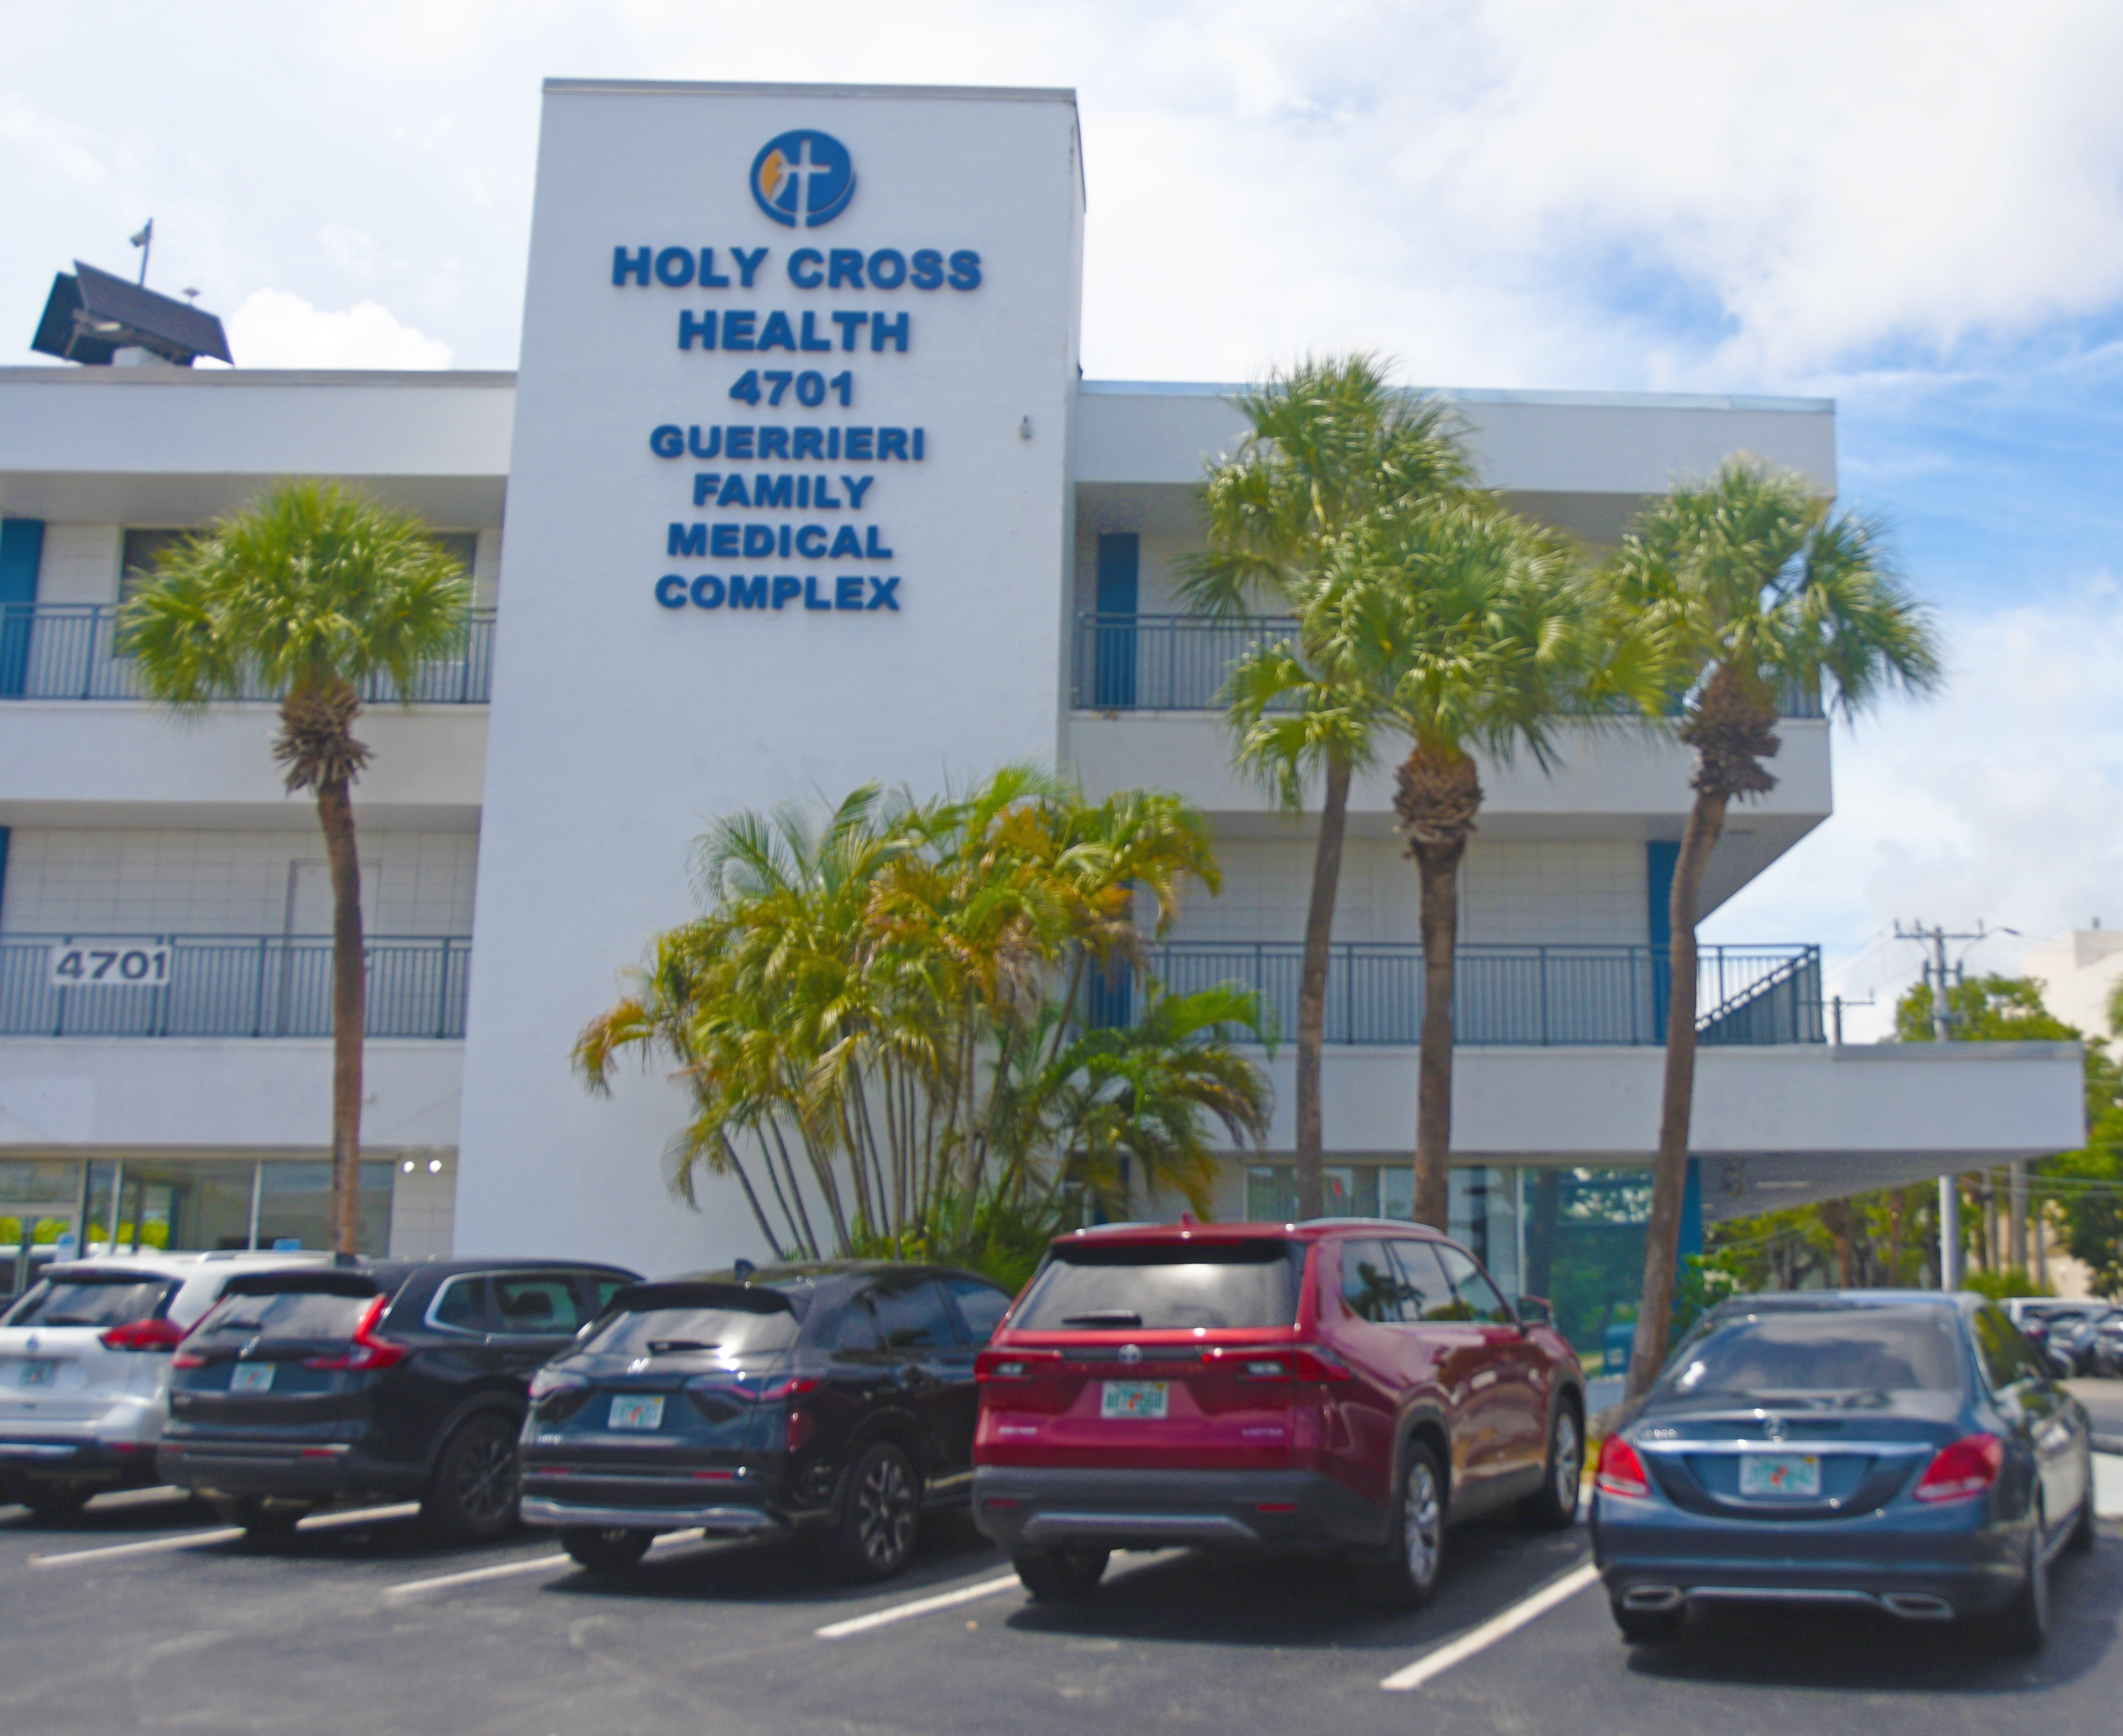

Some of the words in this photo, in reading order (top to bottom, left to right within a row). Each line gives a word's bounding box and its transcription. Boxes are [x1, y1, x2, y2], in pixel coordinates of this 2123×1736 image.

[612, 246, 768, 287] HOLY
[787, 248, 982, 290] CROSS
[678, 310, 909, 352] HEALTH
[729, 370, 852, 406] 4701
[650, 425, 924, 460] GUERRIERI
[693, 473, 873, 508] FAMILY
[667, 523, 892, 559] MEDICAL
[655, 574, 900, 610] COMPLEX
[57, 950, 166, 979] 4701
